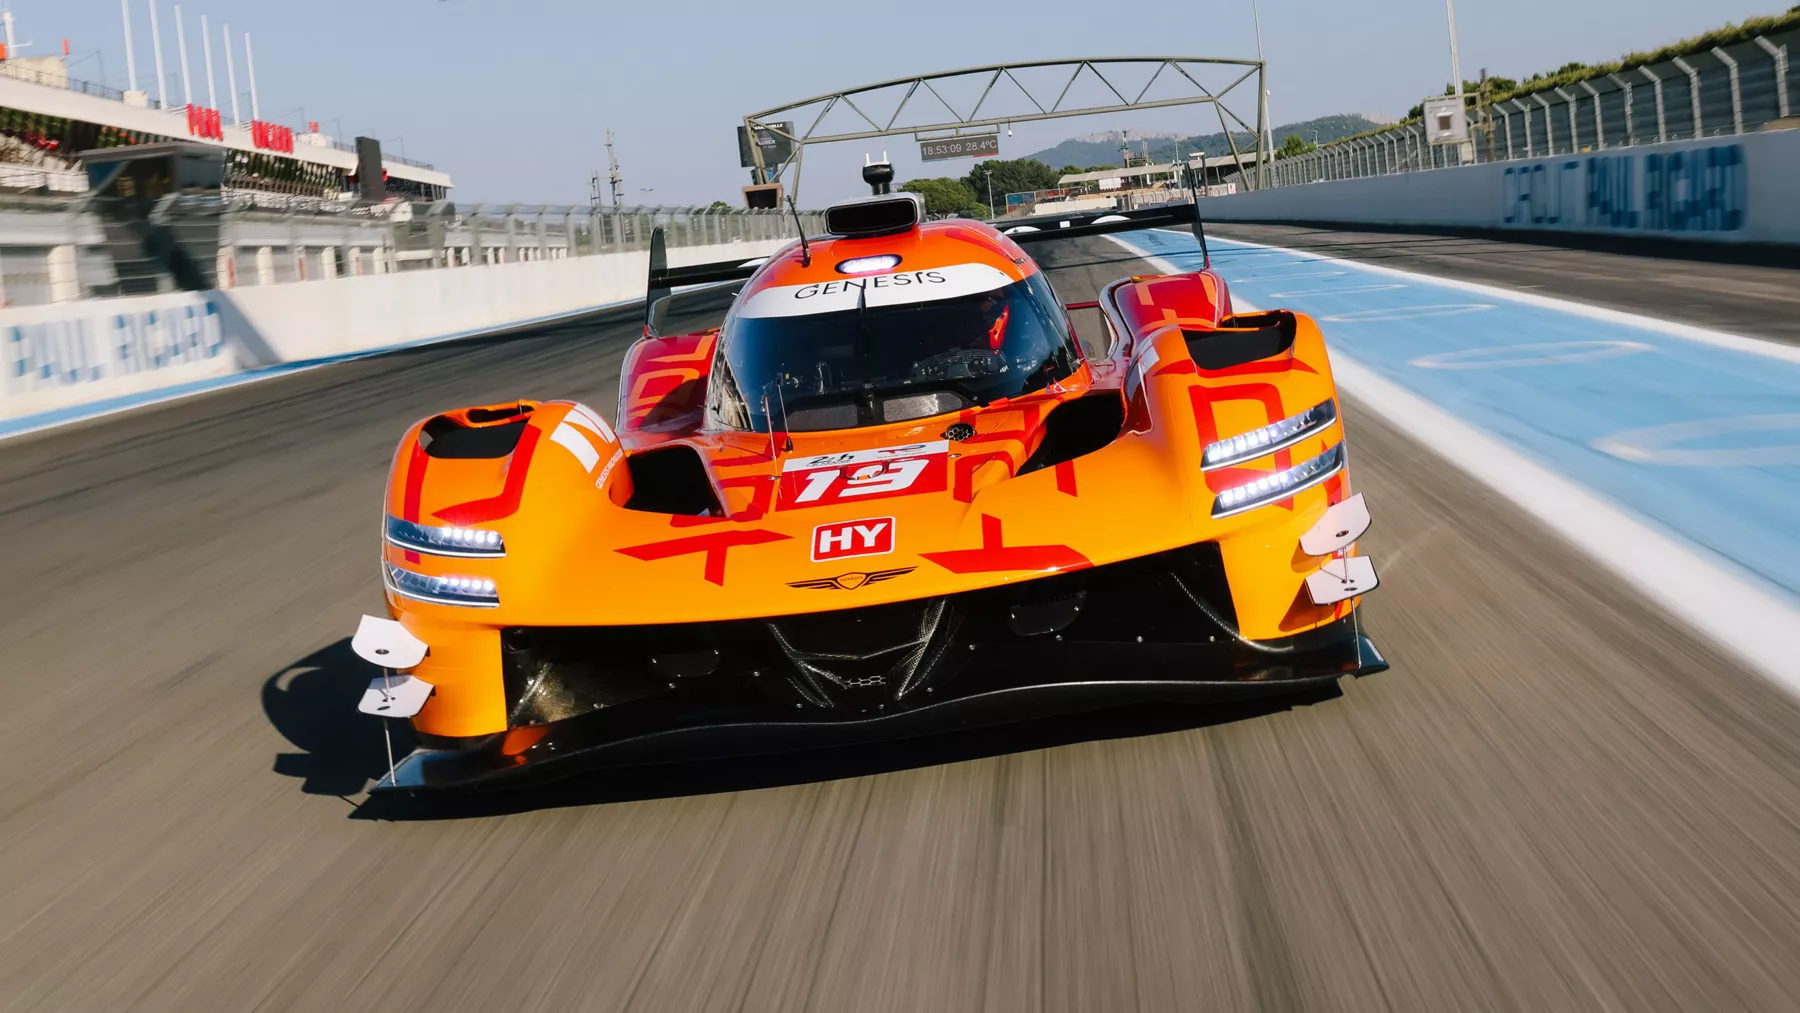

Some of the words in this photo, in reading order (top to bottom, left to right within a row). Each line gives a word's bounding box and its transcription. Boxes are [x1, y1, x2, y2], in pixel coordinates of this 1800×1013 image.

[922, 143, 962, 156] 18:53:09
[794, 271, 946, 300] GENESIS
[794, 458, 930, 504] 19
[819, 522, 888, 554] HY
